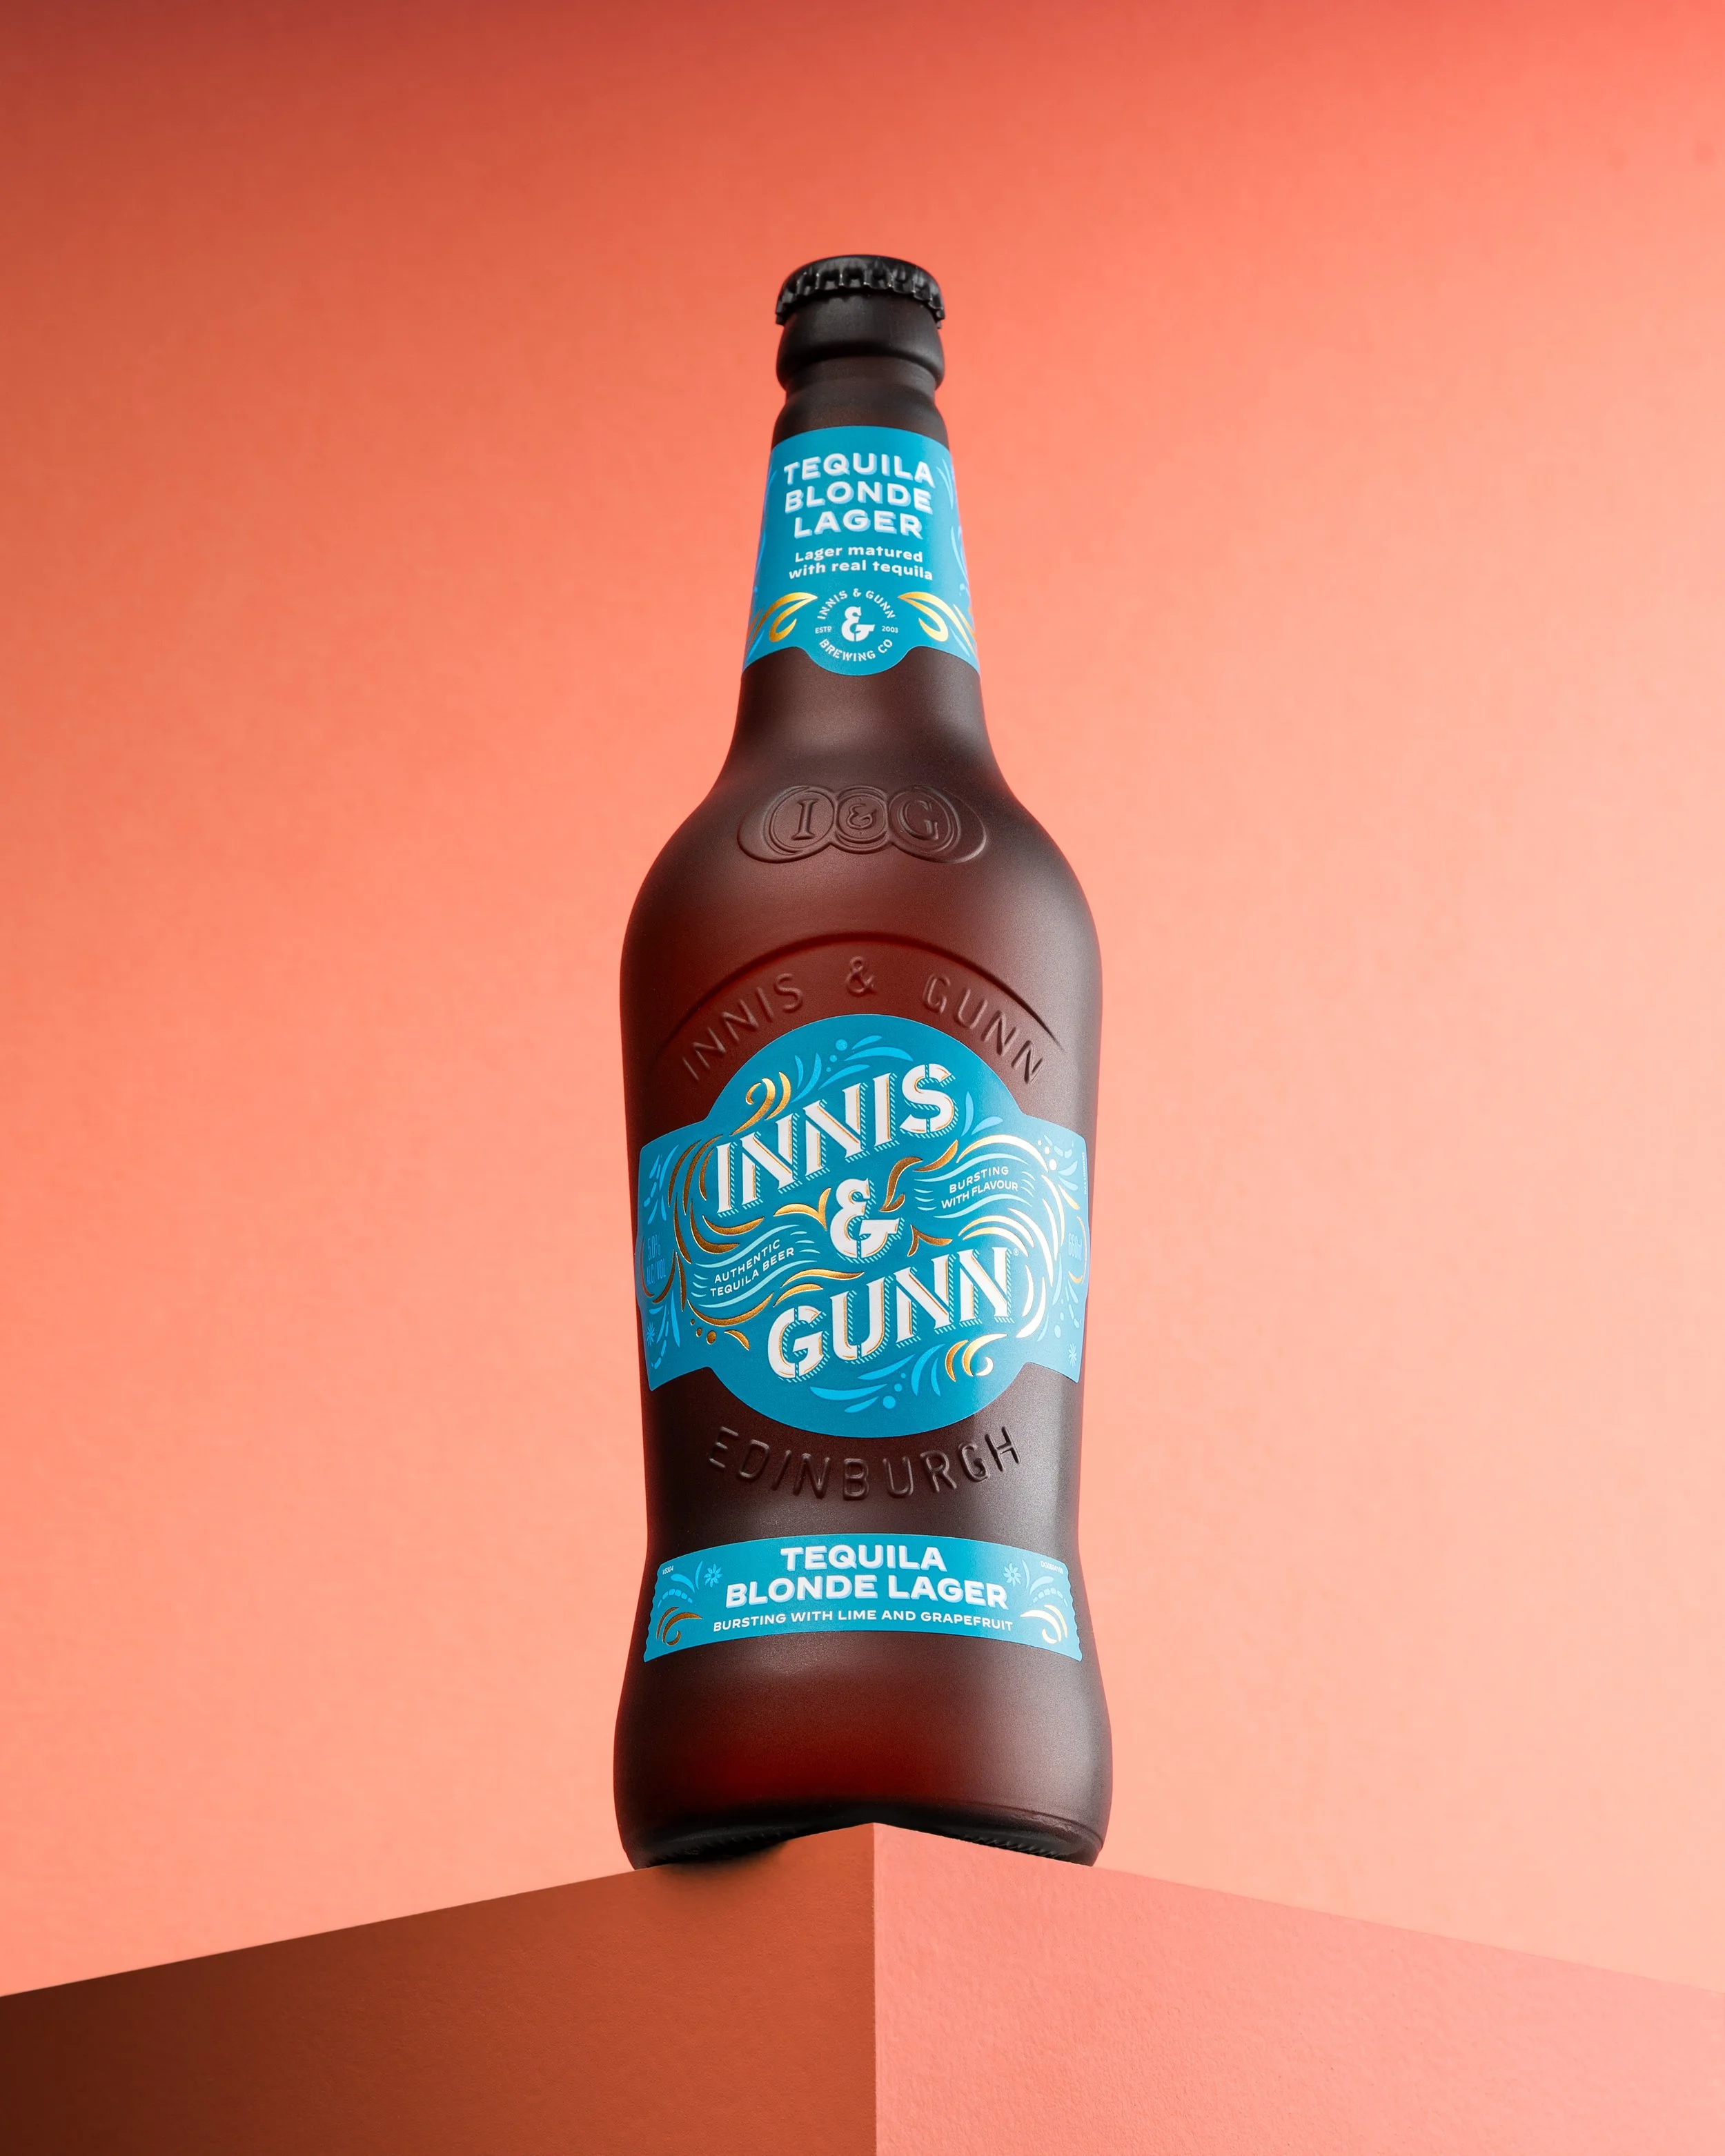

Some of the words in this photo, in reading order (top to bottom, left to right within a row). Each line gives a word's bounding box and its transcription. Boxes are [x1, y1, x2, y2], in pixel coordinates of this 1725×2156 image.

[784, 452, 936, 488] TEQUILA
[785, 481, 933, 515] BLONDE
[793, 508, 923, 540] LAGER
[789, 564, 826, 580] with
[831, 560, 867, 572] real
[873, 561, 933, 580] tequila
[796, 547, 842, 563] Lager
[848, 546, 923, 562] matured
[817, 591, 847, 620] INNIS
[853, 588, 862, 597] &
[865, 591, 896, 619] GUNN
[842, 606, 876, 642] &
[882, 625, 898, 633] 2003
[819, 639, 876, 662] BREWING
[878, 639, 893, 653] CO
[681, 973, 805, 1083] INNIS
[845, 955, 878, 997] &
[923, 971, 1044, 1085] GUNN
[716, 1063, 959, 1218] INNIS
[941, 1191, 969, 1209] WITH
[972, 1180, 1018, 1196] FLAVOUR
[949, 1166, 1009, 1194] BURSTING
[829, 1178, 905, 1263] &
[710, 1269, 759, 1297] TEQUILA
[762, 1247, 794, 1272] BEER
[714, 1239, 780, 1283] AUTHENTIC
[767, 1247, 1014, 1383] GUNN
[707, 1425, 1021, 1501] EDINBURGH
[780, 1544, 947, 1572] TEQUILA
[726, 1575, 878, 1608] BLONDE
[888, 1574, 1009, 1610] LAGER
[713, 1613, 787, 1632] BURSTING
[791, 1610, 833, 1622] WITH
[838, 1610, 876, 1621] LIME
[881, 1610, 916, 1621] AND
[920, 1612, 1013, 1631] GRAPEFRUIT
